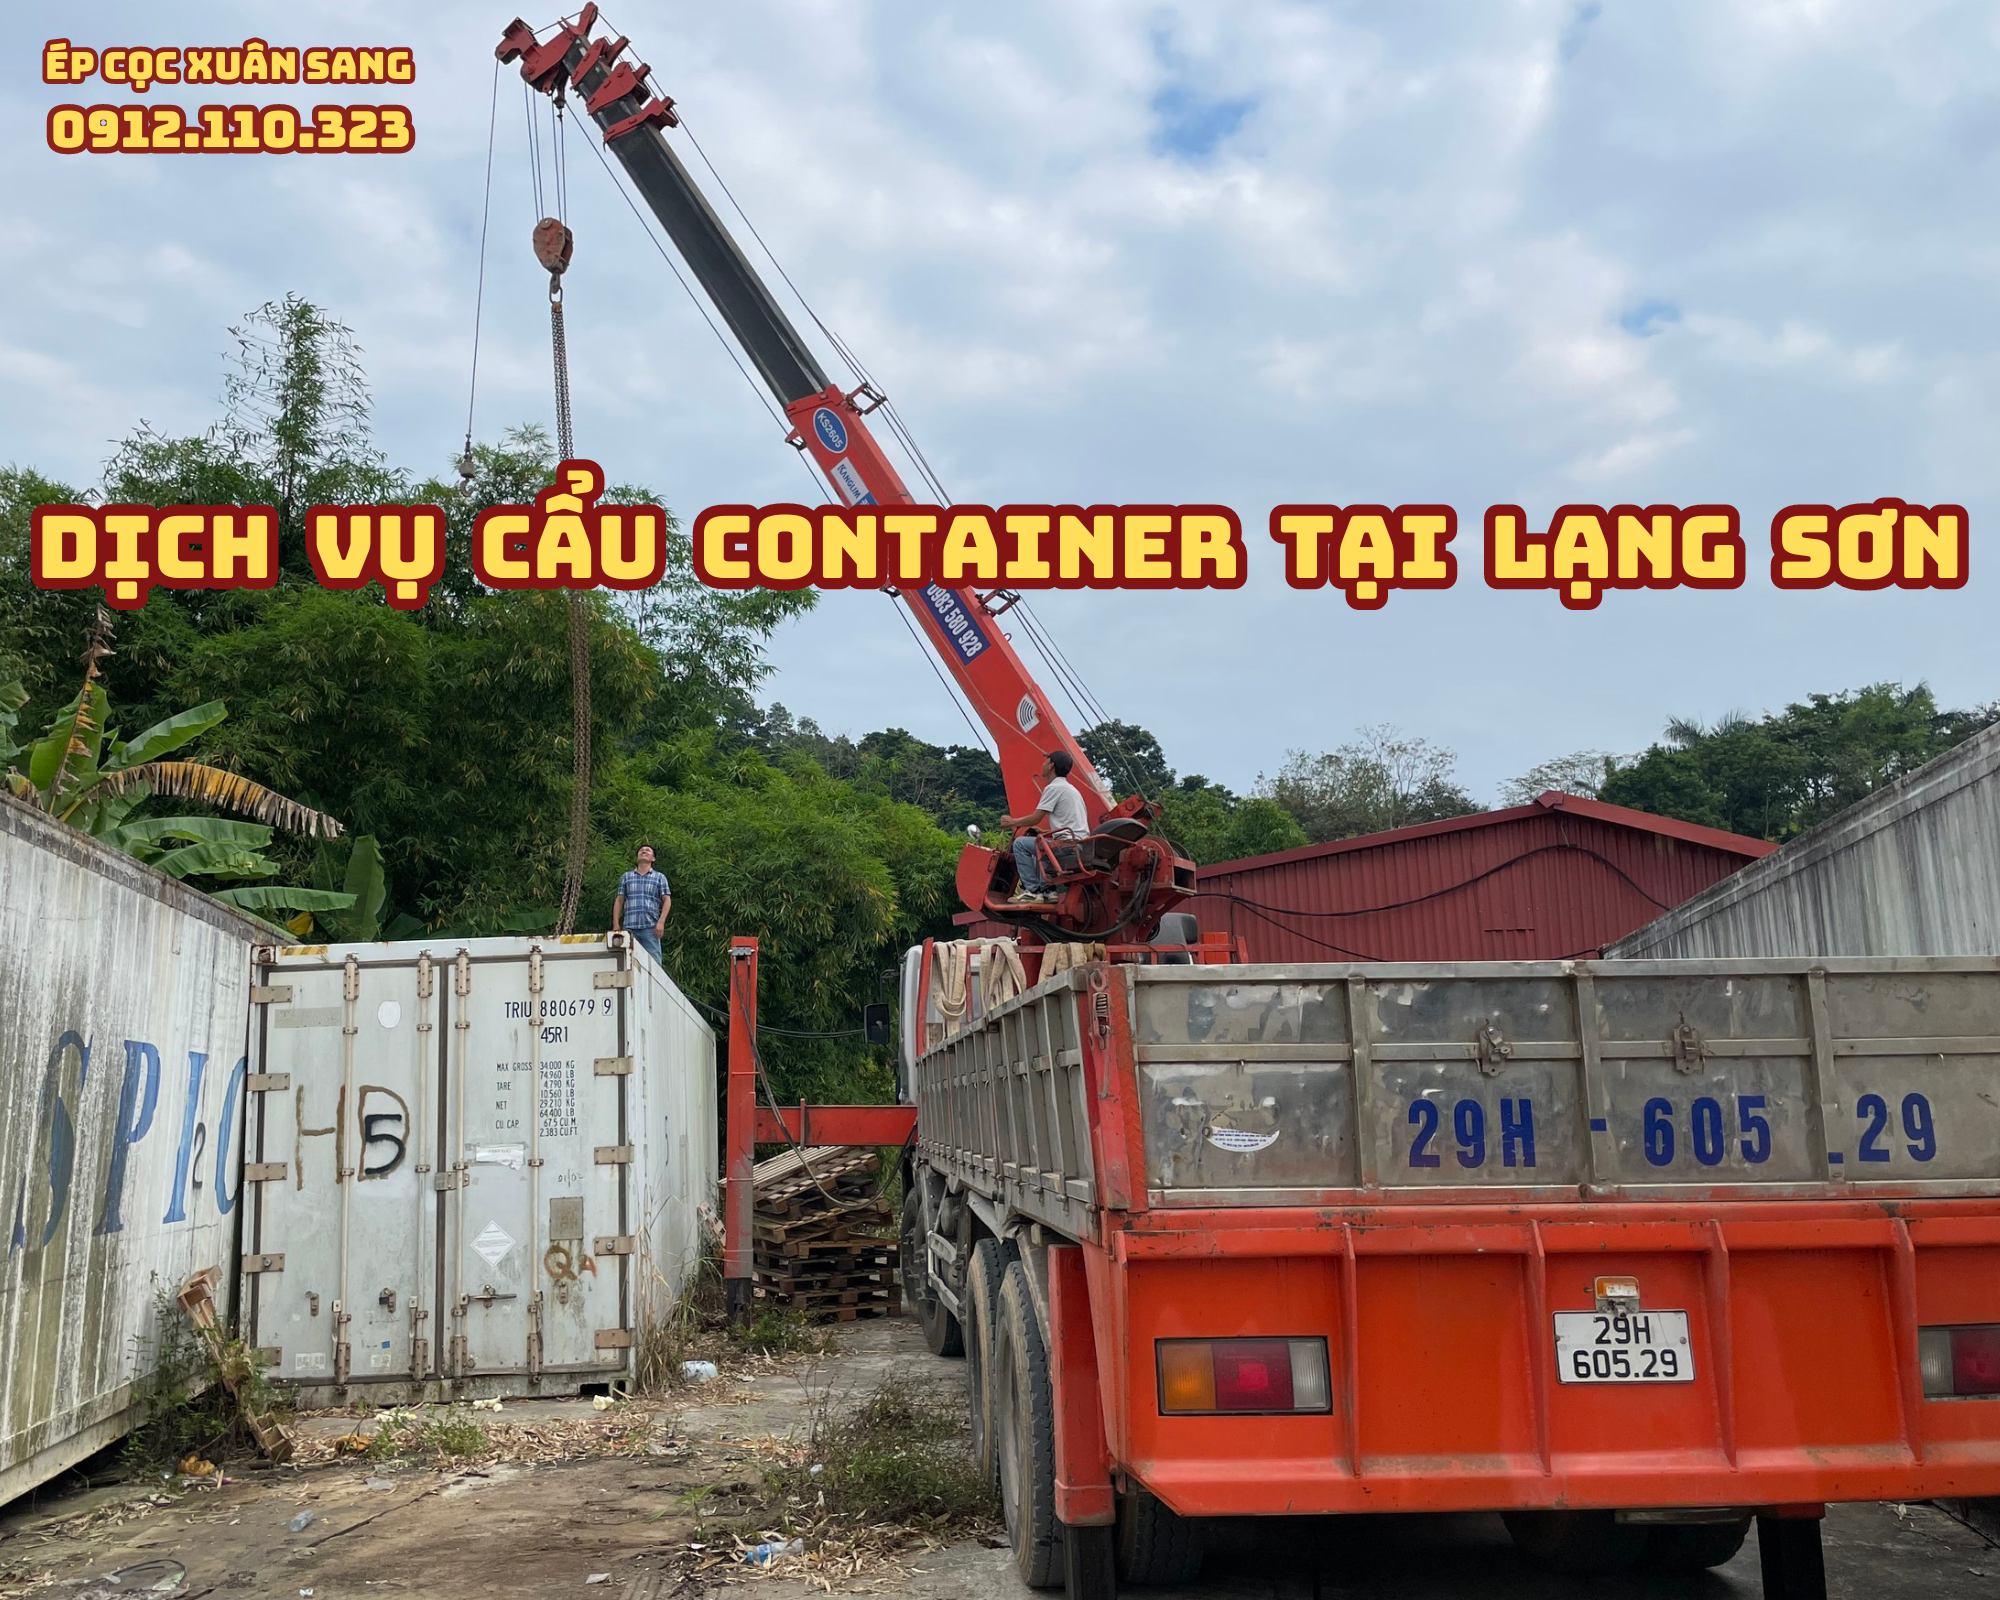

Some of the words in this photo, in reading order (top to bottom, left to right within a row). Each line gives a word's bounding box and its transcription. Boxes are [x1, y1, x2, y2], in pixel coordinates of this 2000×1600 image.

[817, 412, 843, 448] KS2605
[837, 464, 862, 499] KANGLIM
[944, 607, 969, 636] 580
[958, 629, 983, 657] 928
[504, 1001, 532, 1018] TRIU
[540, 999, 595, 1017] 880679
[603, 998, 612, 1015] 9
[540, 1026, 568, 1043] 45R1
[496, 1062, 509, 1072] MAX
[513, 1061, 533, 1072] GROSS
[566, 1060, 575, 1069] KG
[566, 1069, 575, 1079] LB
[566, 1079, 575, 1088] KG
[566, 1089, 575, 1098] LB
[496, 1101, 507, 1110] NET
[566, 1098, 575, 1107] KG
[566, 1107, 575, 1117] LB
[1408, 1098, 1537, 1169] 29H
[1643, 1095, 1771, 1167] 605
[365, 1114, 406, 1175] 5
[1593, 1315, 1651, 1345] 29H
[1573, 1349, 1679, 1379] 605.29
